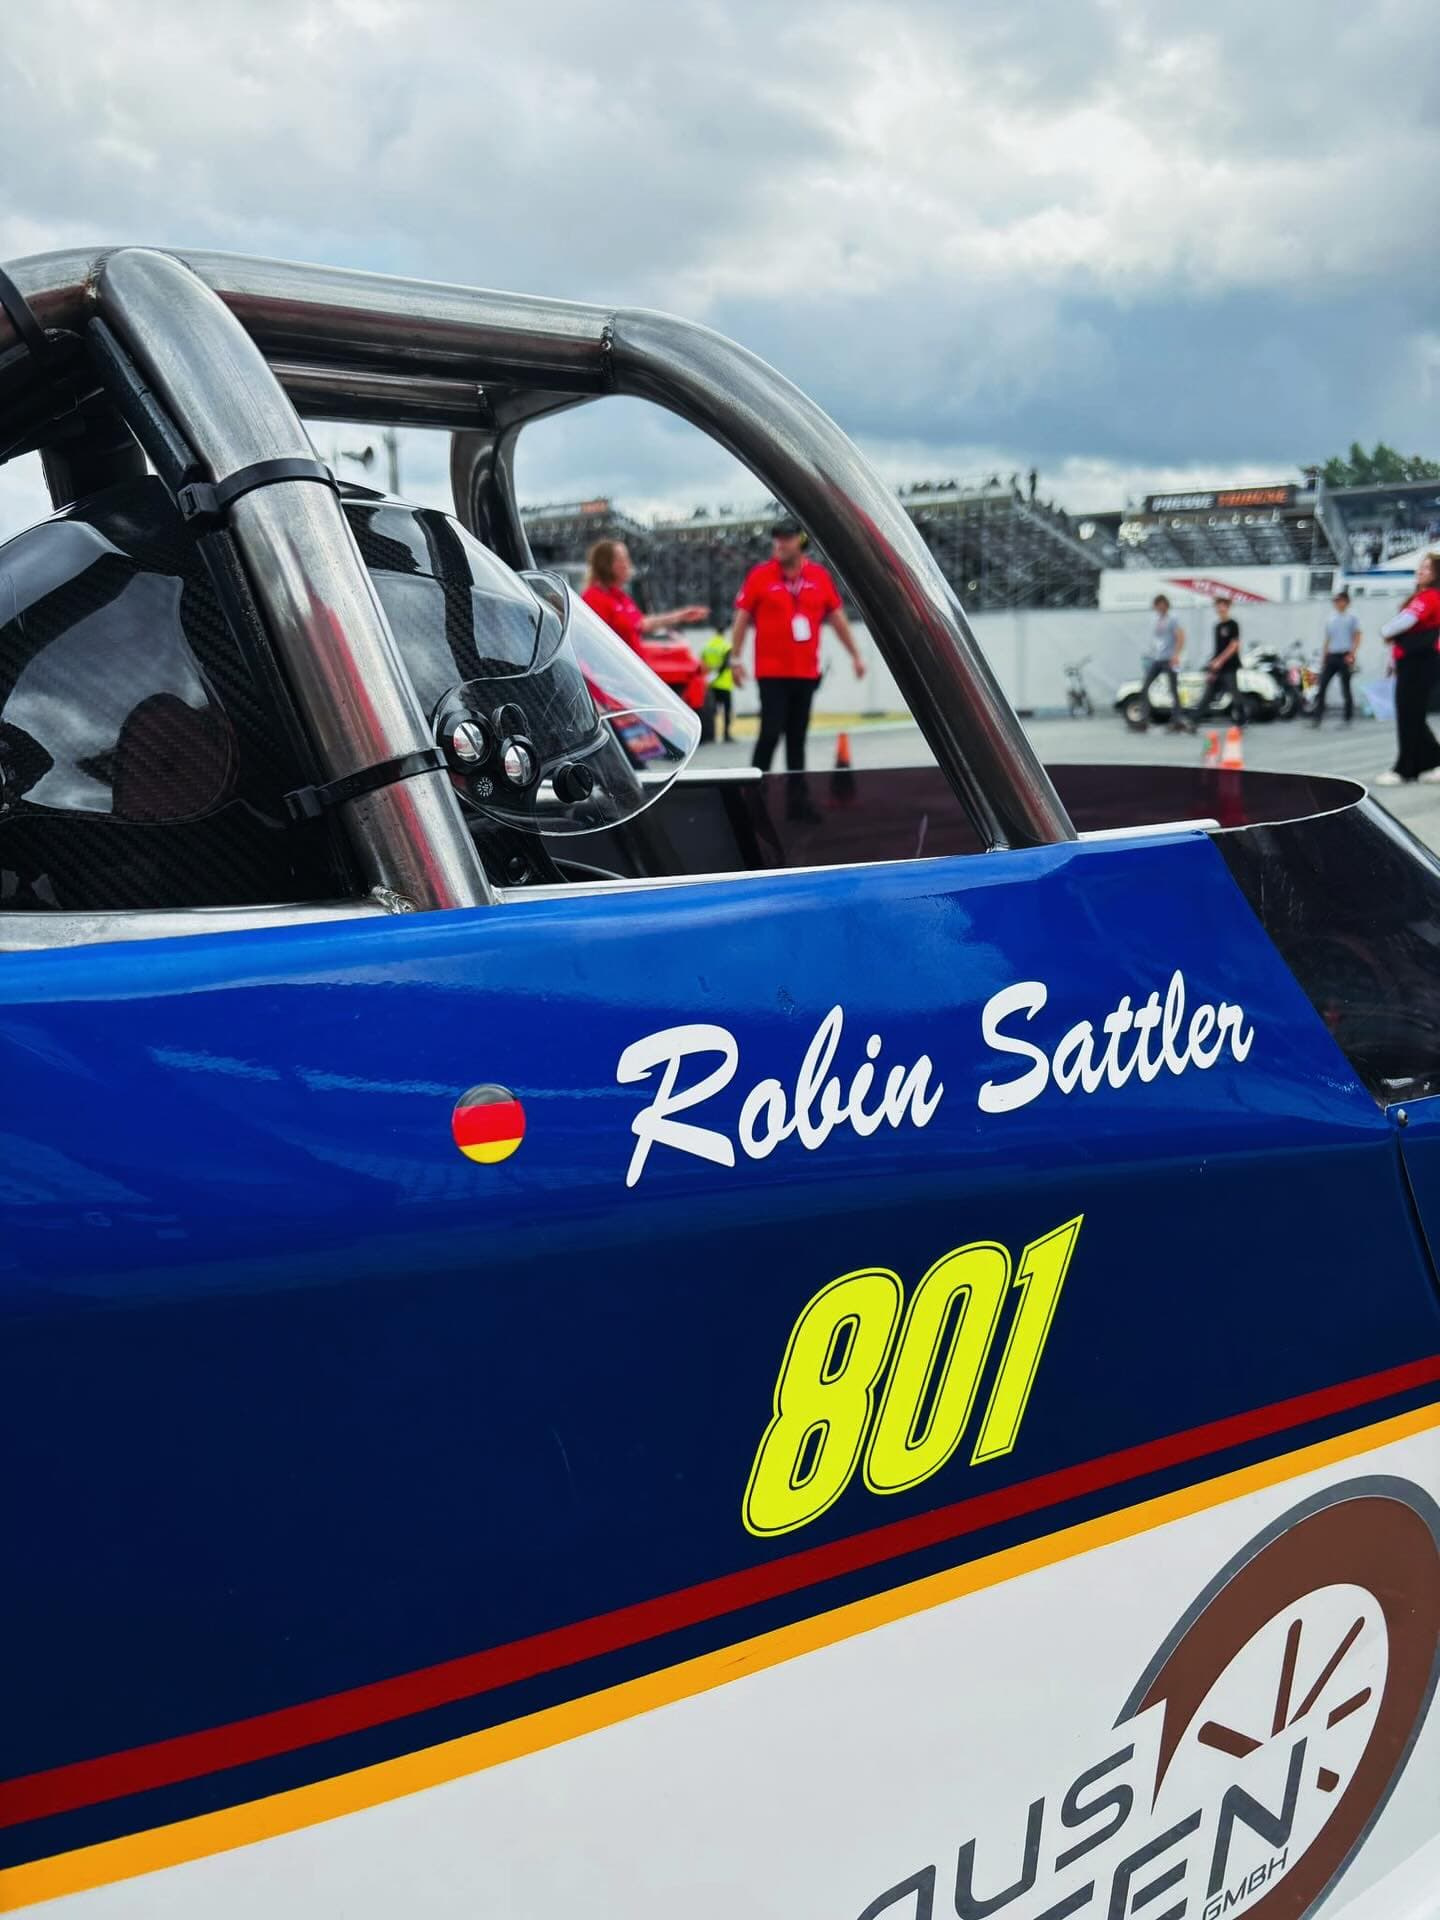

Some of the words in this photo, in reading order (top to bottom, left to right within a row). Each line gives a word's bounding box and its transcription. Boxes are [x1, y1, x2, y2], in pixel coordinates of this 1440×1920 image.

[616, 1005, 944, 1188] Robin
[977, 969, 1255, 1114] Sattler
[741, 1215, 1084, 1538] 801
[1203, 1846, 1289, 1920] GMBH
